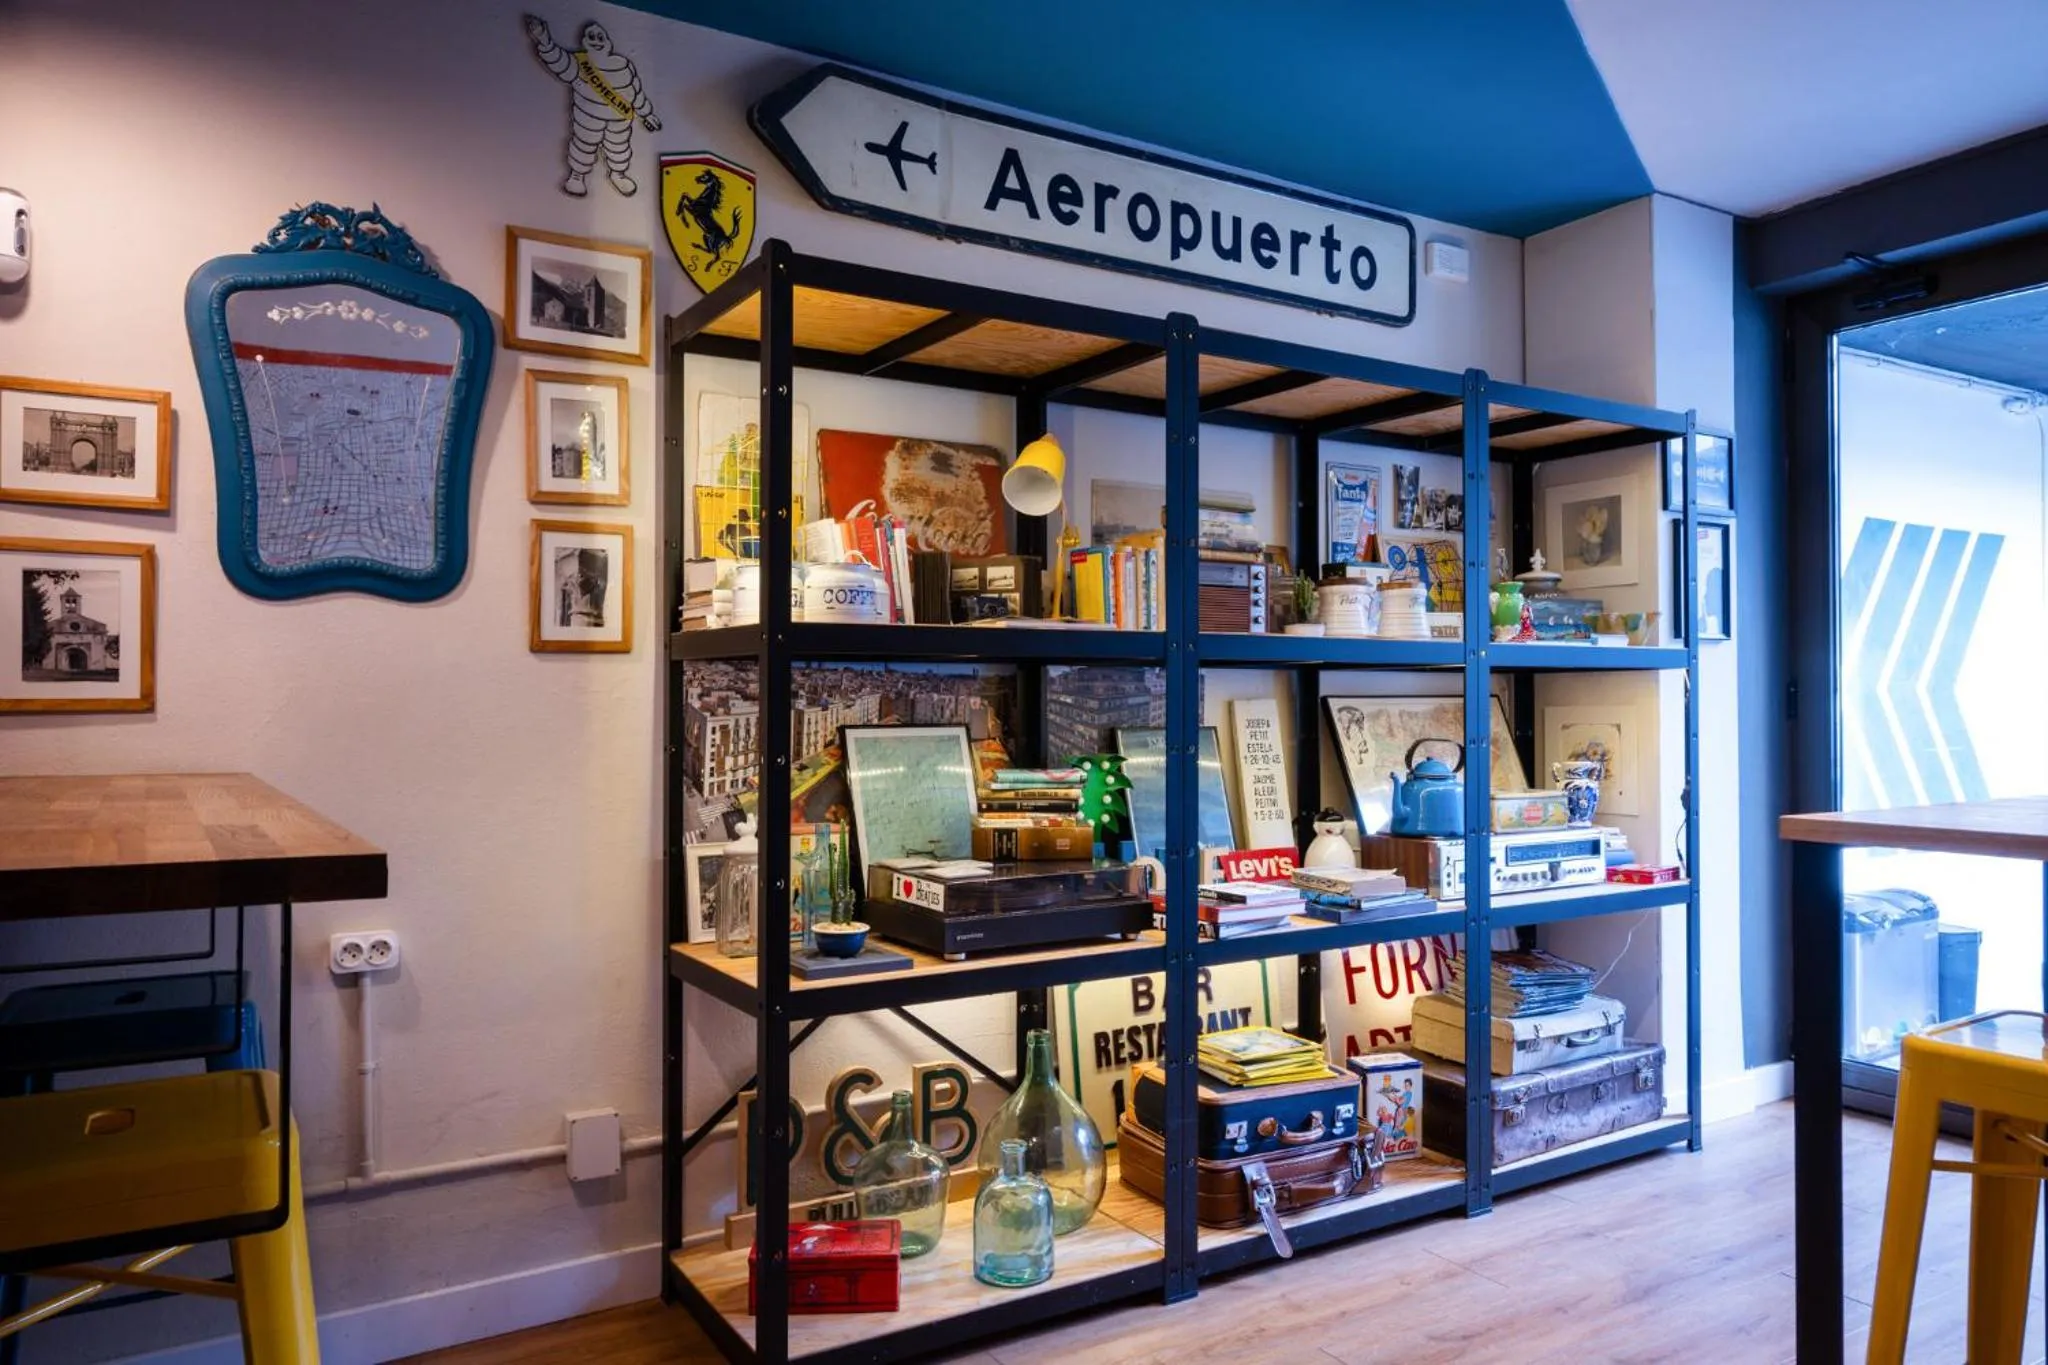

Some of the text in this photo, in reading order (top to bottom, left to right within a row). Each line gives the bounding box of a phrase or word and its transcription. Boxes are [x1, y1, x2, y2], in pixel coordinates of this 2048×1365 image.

[580, 60, 631, 115] MICHELIN
[984, 147, 1377, 292] Aeropuerto
[896, 877, 901, 897] I
[1131, 966, 1213, 1017] BR
[1093, 1006, 1253, 1071] RESTAANT
